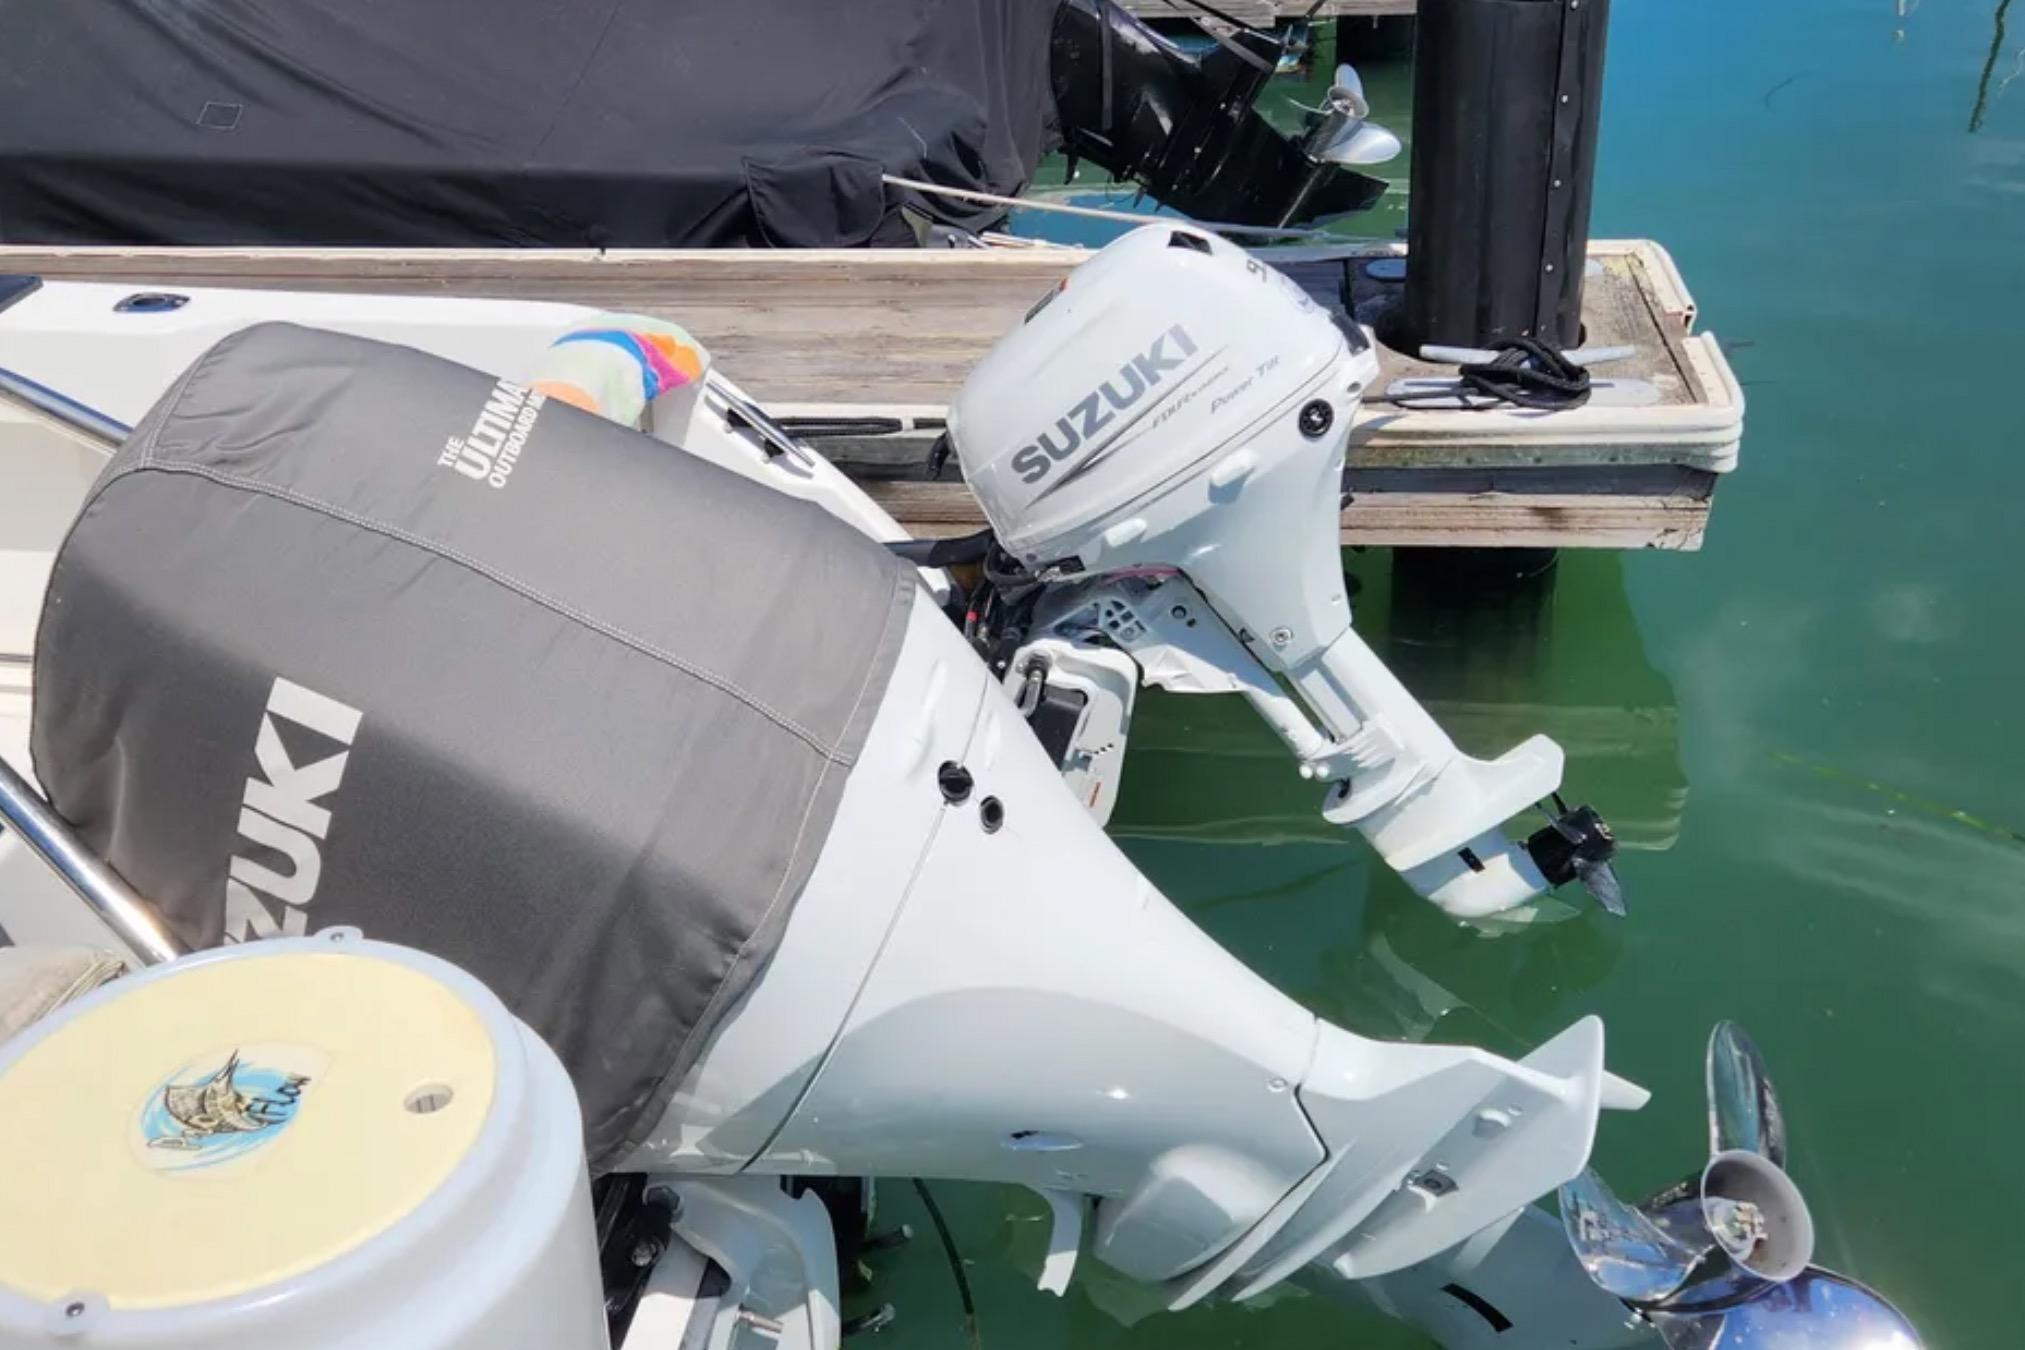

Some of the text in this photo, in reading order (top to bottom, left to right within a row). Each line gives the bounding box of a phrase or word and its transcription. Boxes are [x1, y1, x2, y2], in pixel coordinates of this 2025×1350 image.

[1011, 323, 1199, 484] SUZUKI
[1210, 376, 1254, 415] Power
[437, 436, 465, 467] THE
[488, 406, 539, 489] OUTBOARD
[223, 676, 364, 947] ZUKI
